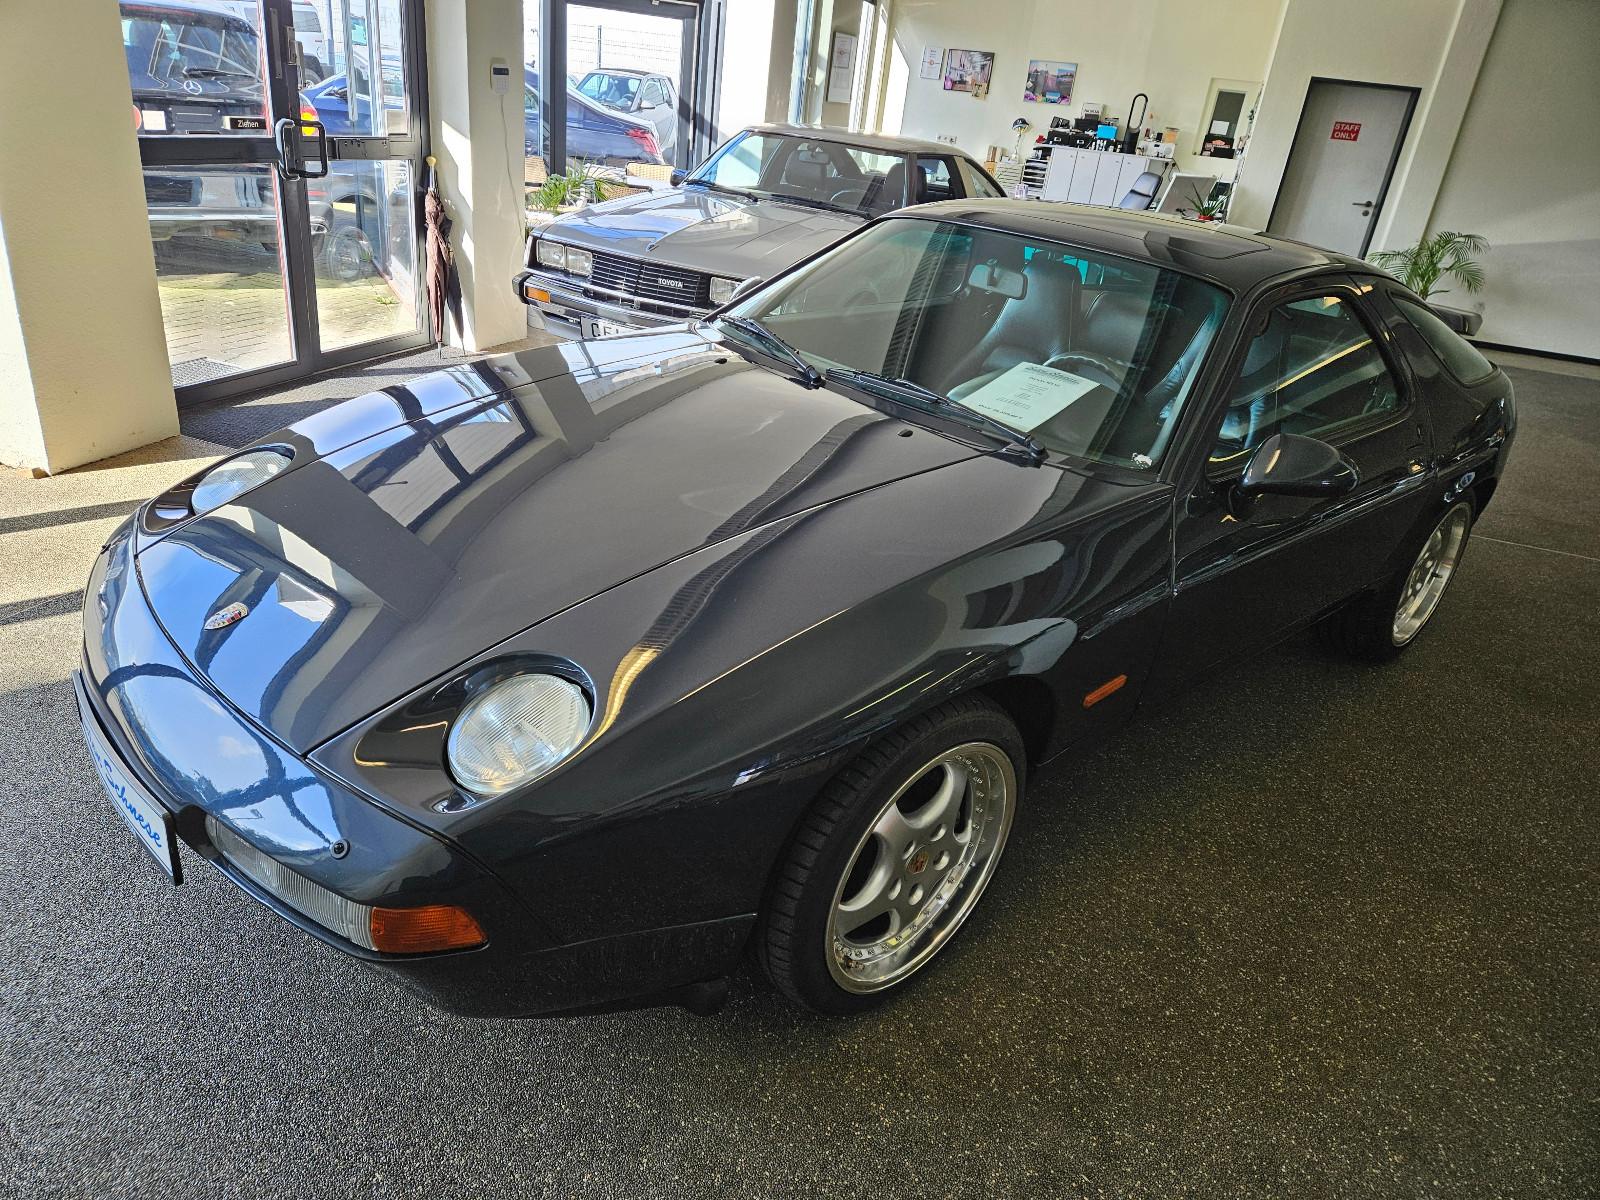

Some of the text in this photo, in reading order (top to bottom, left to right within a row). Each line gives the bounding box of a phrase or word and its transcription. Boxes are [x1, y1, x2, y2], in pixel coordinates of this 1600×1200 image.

[237, 119, 259, 128] Ziehen
[1335, 123, 1361, 132] STAFF
[1334, 131, 1356, 140] ONLY
[658, 277, 683, 289] TOYOTA
